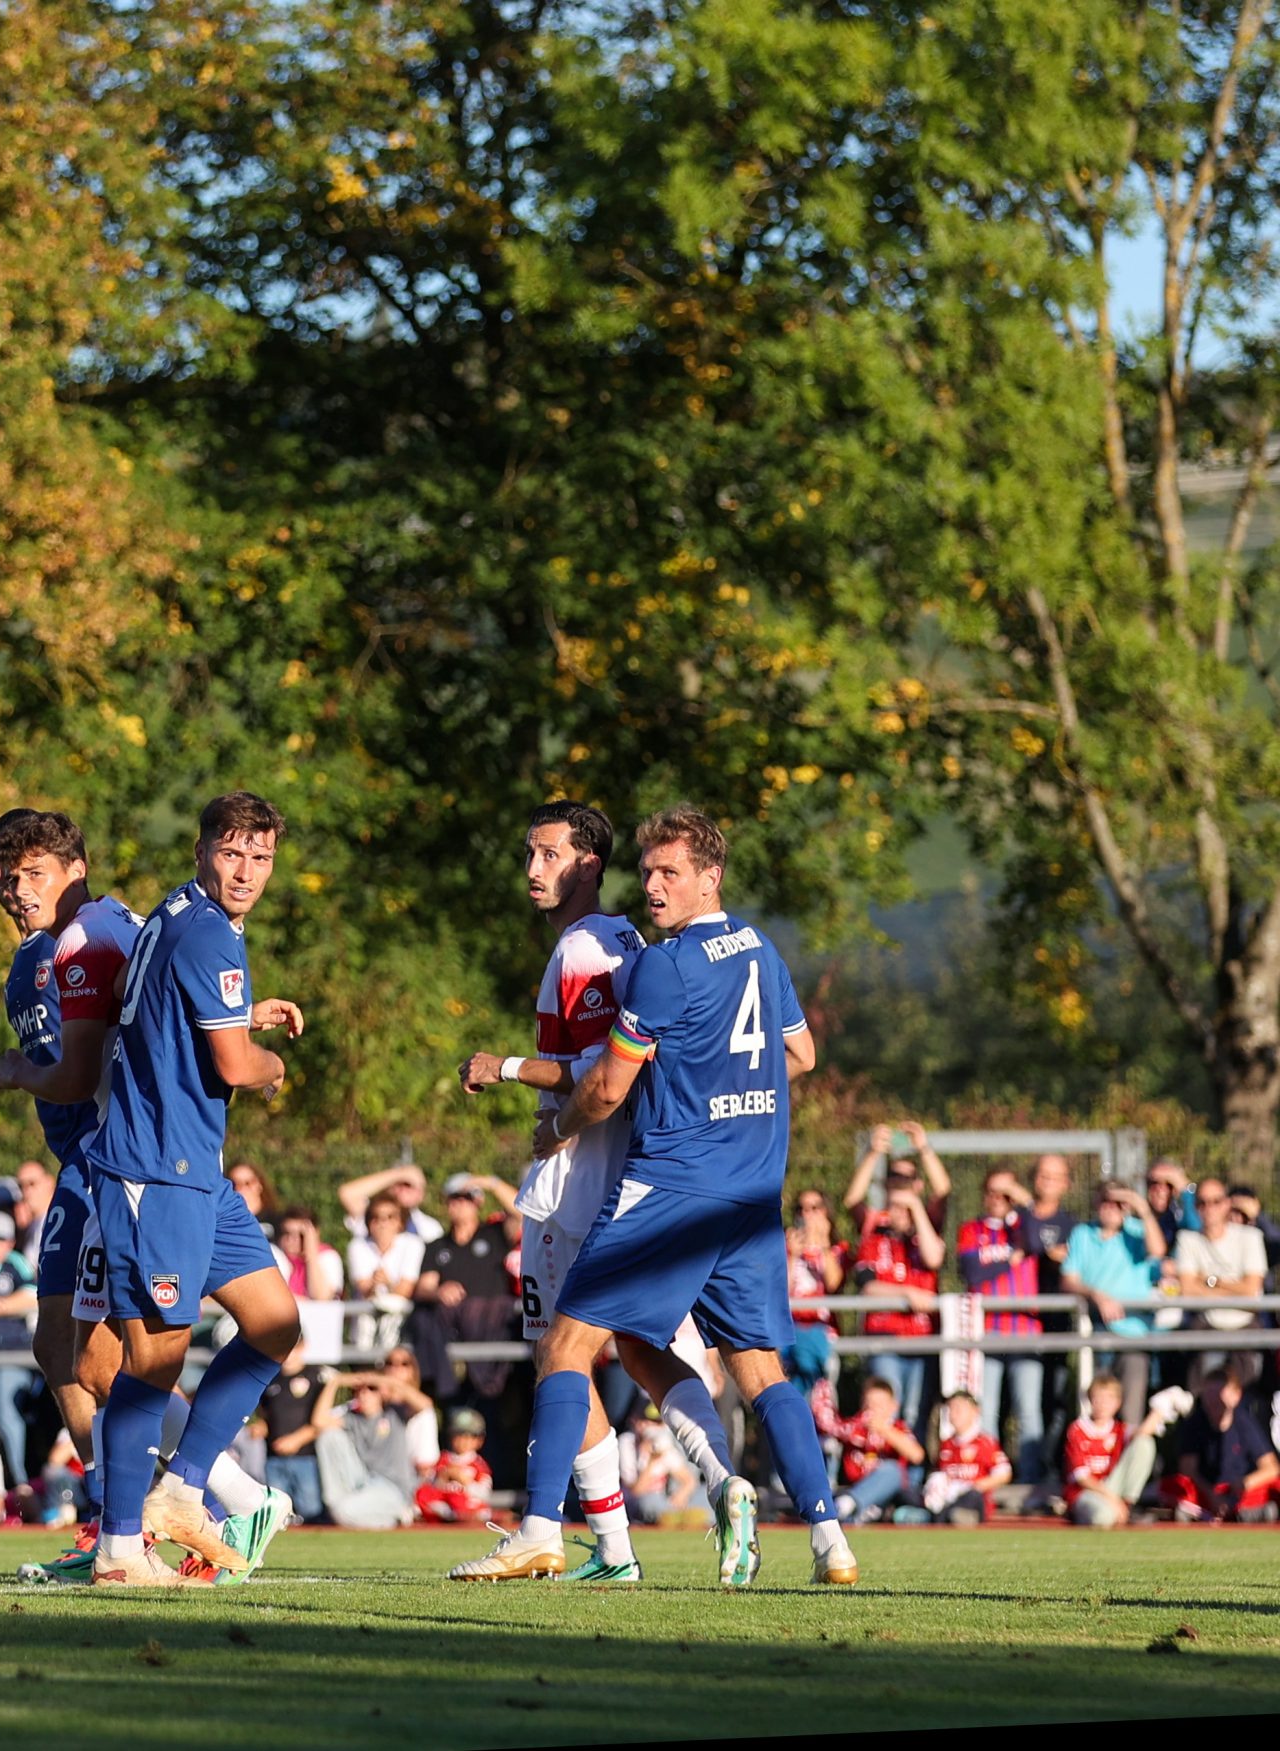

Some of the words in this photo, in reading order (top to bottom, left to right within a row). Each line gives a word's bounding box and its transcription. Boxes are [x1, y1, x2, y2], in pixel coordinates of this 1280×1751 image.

[729, 959, 766, 1070] 4
[156, 1289, 174, 1300] FCH
[80, 1297, 105, 1309] JAKO
[527, 1320, 549, 1329] JAKO
